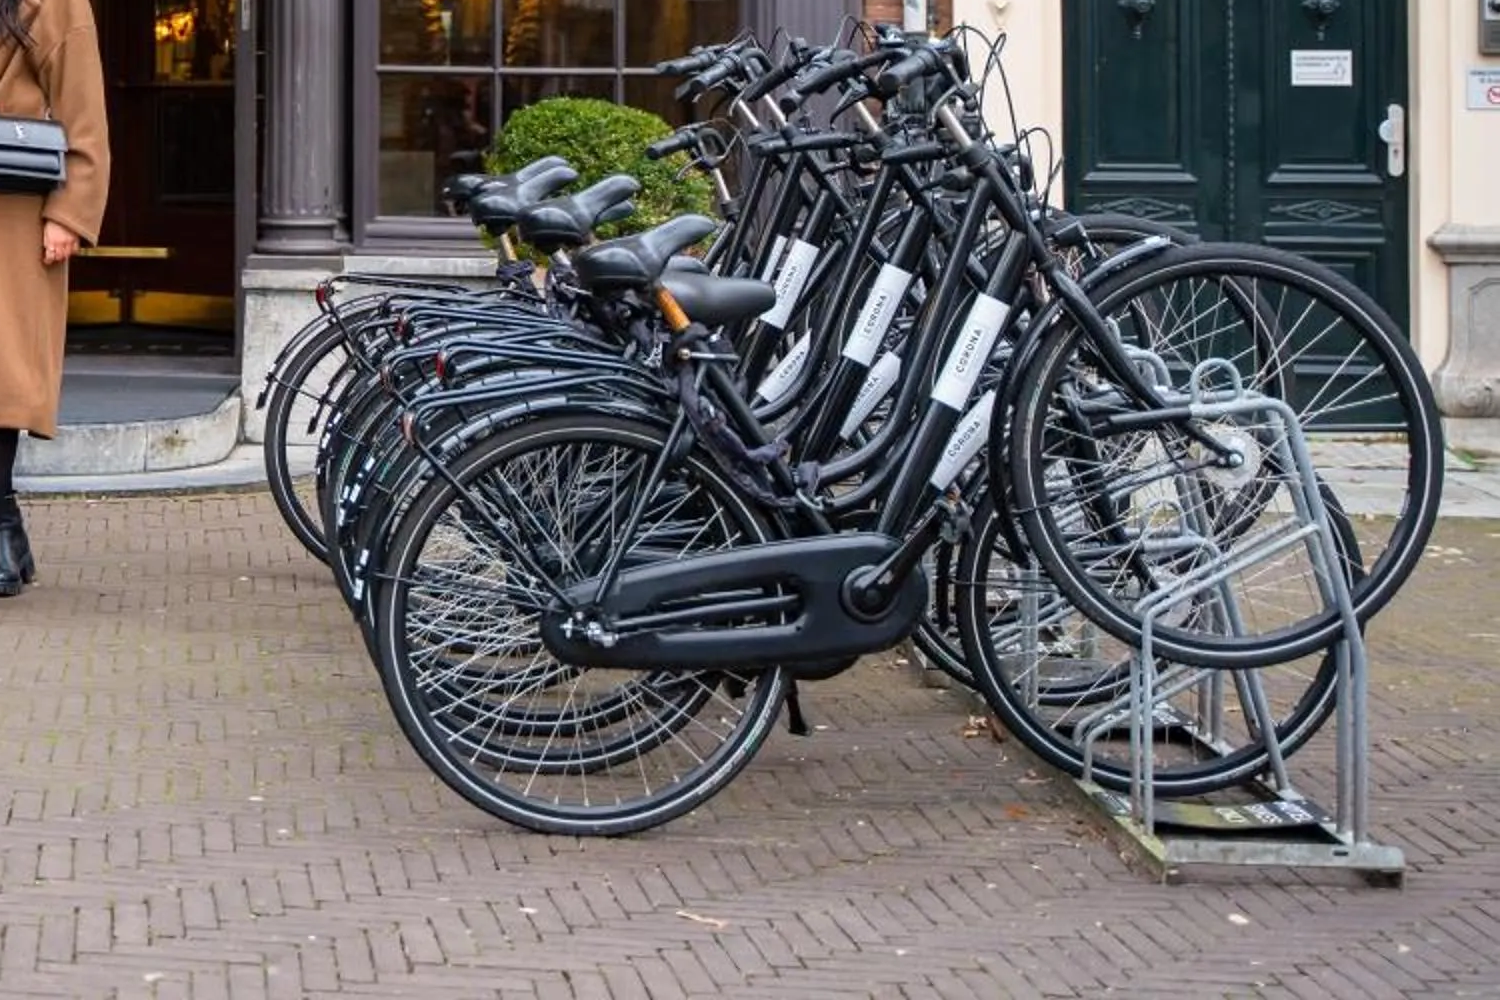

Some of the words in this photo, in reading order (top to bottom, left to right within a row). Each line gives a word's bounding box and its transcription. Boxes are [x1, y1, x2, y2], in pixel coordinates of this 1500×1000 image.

[863, 294, 887, 335] CORONA
[956, 329, 982, 374] CORONA
[947, 421, 981, 457] CORONA
